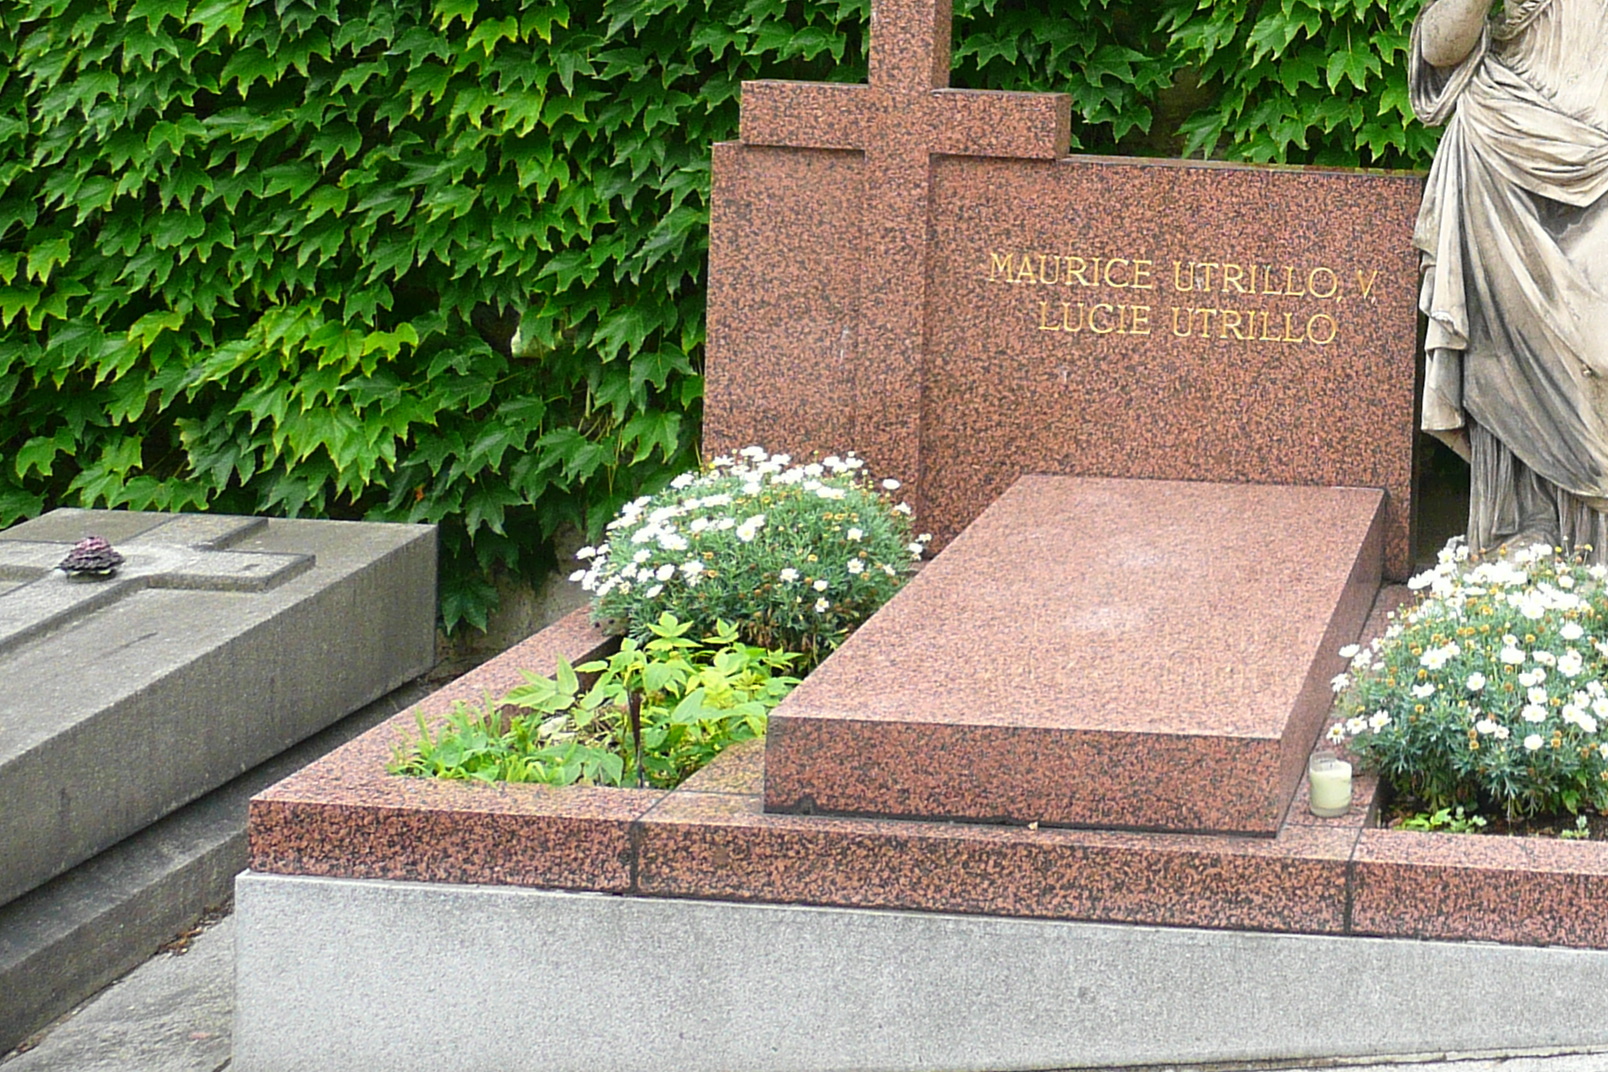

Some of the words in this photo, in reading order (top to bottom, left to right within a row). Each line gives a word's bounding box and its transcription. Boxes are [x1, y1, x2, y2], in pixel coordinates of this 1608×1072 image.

[989, 252, 1153, 290] MAURICE
[1173, 260, 1343, 304] UTRILLO,
[1039, 301, 1151, 335] LUCIE
[1172, 306, 1337, 345] UTRILLO
